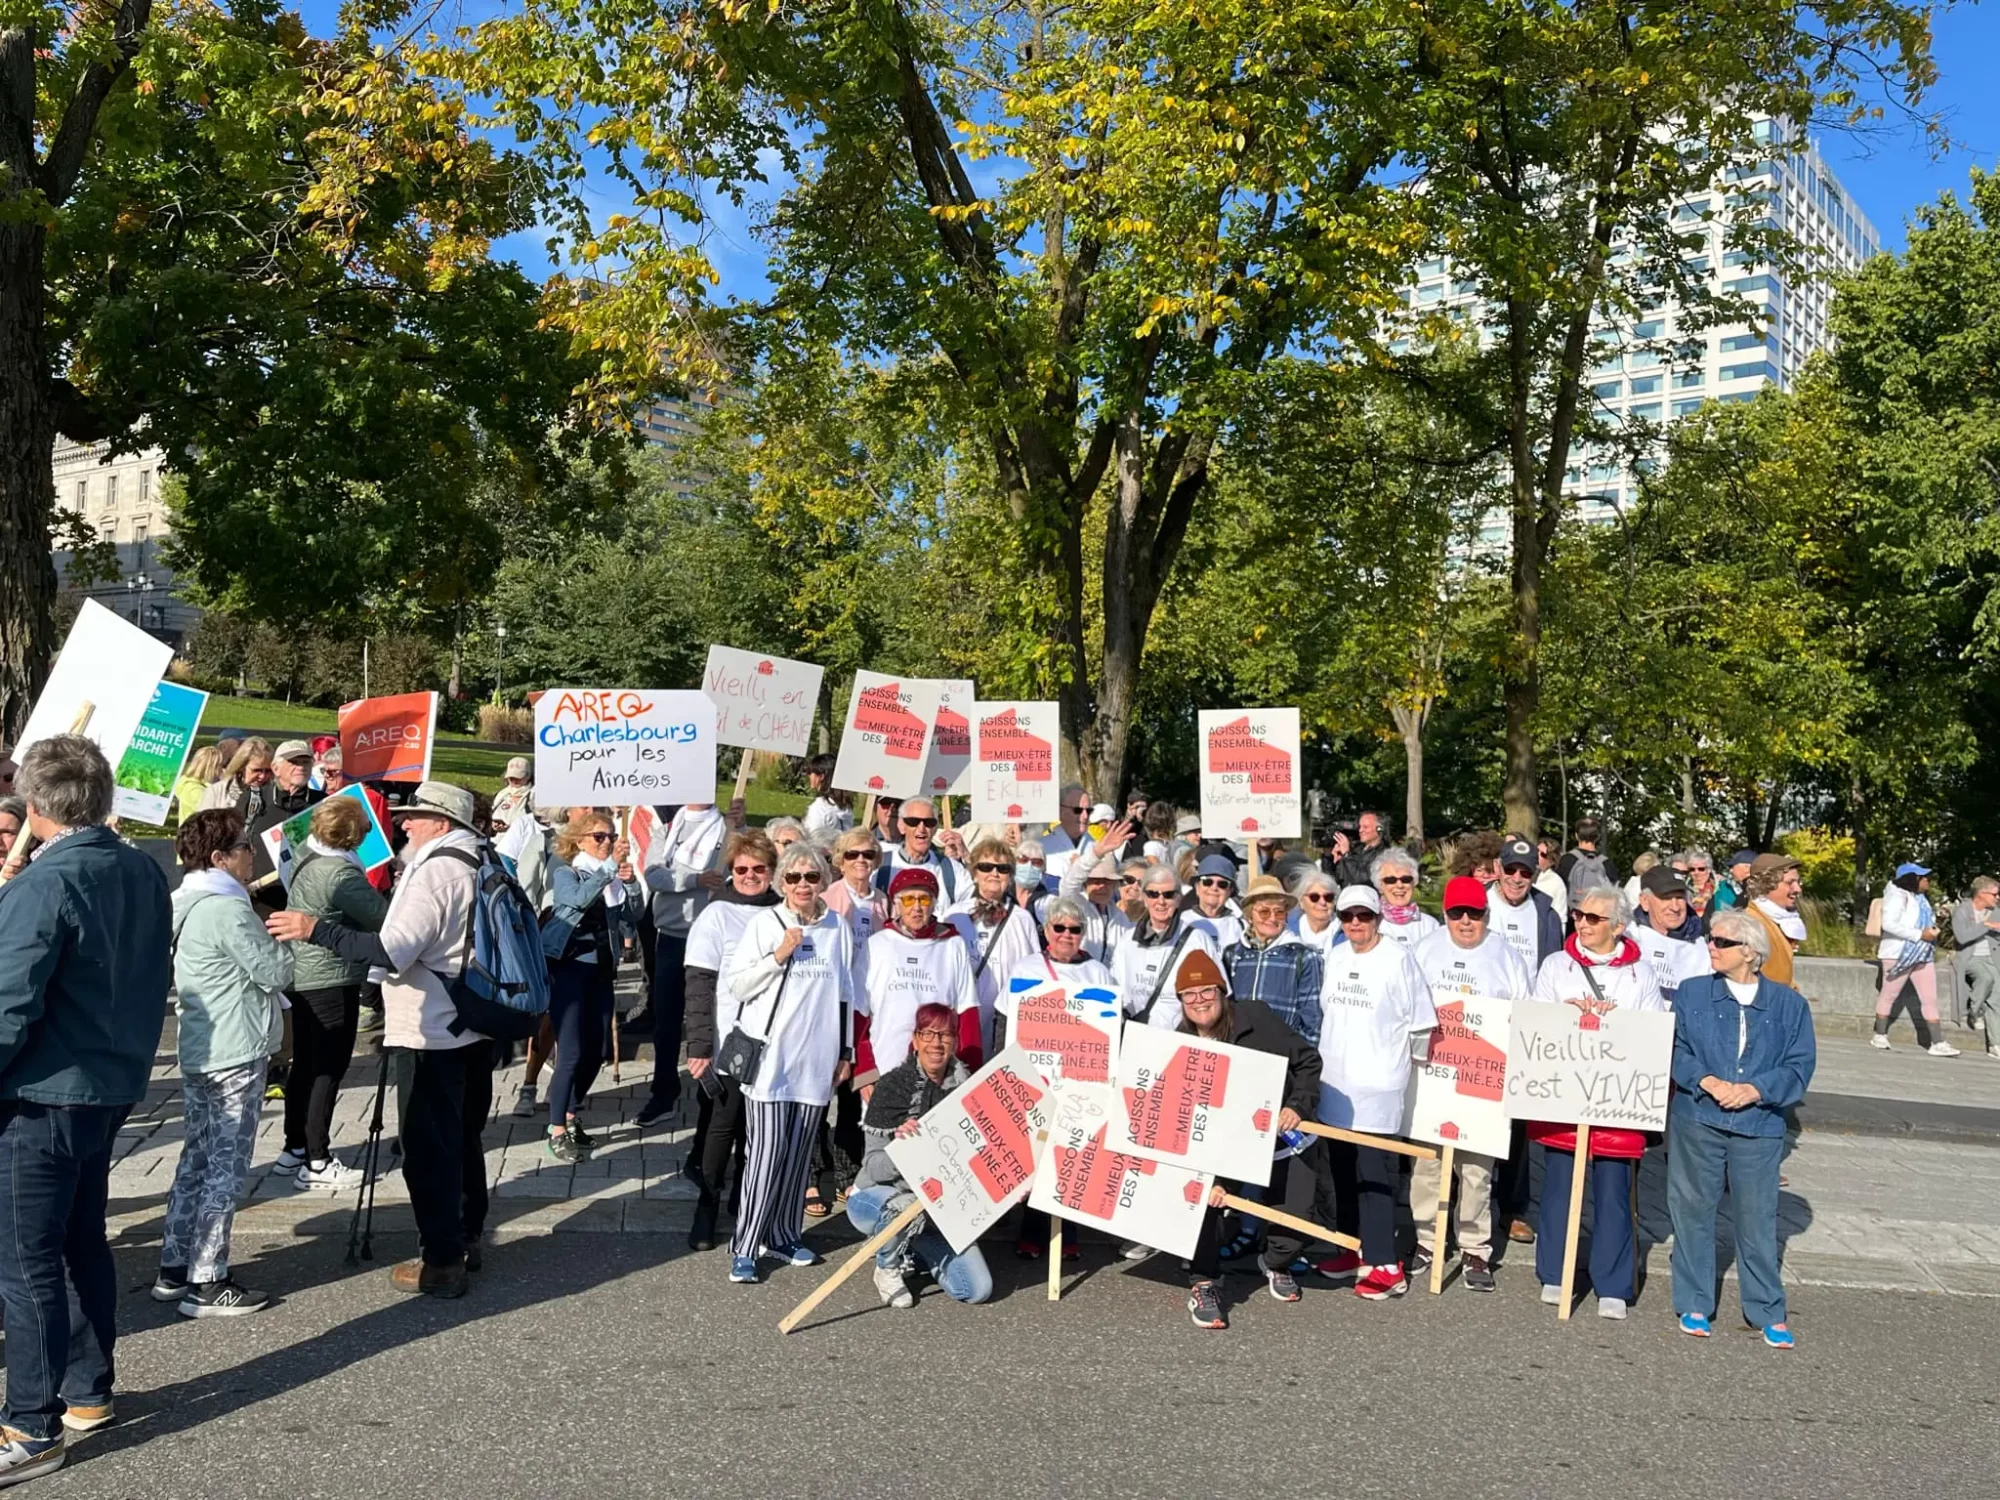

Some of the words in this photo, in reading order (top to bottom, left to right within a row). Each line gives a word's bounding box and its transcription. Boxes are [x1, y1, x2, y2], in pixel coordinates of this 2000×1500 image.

[861, 686, 913, 704] AGISSONS
[553, 691, 654, 723] AREQ
[858, 698, 909, 716] ENSEMBLE
[867, 721, 926, 740] MIEUX-ÊTRE
[980, 716, 1031, 727] AGISSONS
[1208, 724, 1267, 736] AGISSONS
[353, 723, 421, 750] AREQ
[539, 719, 697, 748] Charlesbourg
[862, 732, 882, 745] DES
[979, 728, 1029, 739] ENSEMBLE
[1208, 738, 1266, 749] ENSEMBLE
[569, 748, 617, 772] pour
[636, 743, 666, 763] les
[994, 748, 1052, 760] MIEUX-ÊTRE
[990, 763, 1010, 773] DES
[1225, 759, 1292, 771] MIEUX-ÊTRE
[1221, 774, 1243, 785] DES
[895, 967, 932, 981] Vieillir,
[1441, 969, 1478, 986] Vieillir,
[910, 980, 938, 993] vivre.
[1337, 981, 1369, 997] Vieillir,
[1019, 996, 1084, 1011] AGISSONS
[1347, 996, 1374, 1010] vivre.
[1017, 1010, 1082, 1026] ENSEMBLE
[1573, 1020, 1609, 1030] HABITATS
[1034, 1038, 1110, 1055] MIEUX-ÊTRE
[1029, 1053, 1054, 1066] DES
[1425, 1063, 1450, 1080] DES
[1000, 1064, 1046, 1128] AGISSONS
[1176, 1047, 1200, 1133] MIEUX-ÊTRE
[1574, 1069, 1667, 1111] VIVRE
[986, 1073, 1033, 1138] ENSEMBLE
[1127, 1067, 1150, 1145] AGISSONS
[1143, 1072, 1166, 1149] ENSEMBLE
[924, 1113, 939, 1139] Le
[1260, 1099, 1271, 1138] HABITATS
[958, 1117, 980, 1145] DES
[1192, 1114, 1207, 1142] DES
[975, 1110, 1028, 1184] MIEUX-ÊTRE
[1053, 1127, 1084, 1204] AGISSONS
[1069, 1134, 1100, 1210] ENSEMBLE
[938, 1164, 957, 1186] est
[1105, 1153, 1125, 1198] MIEUX
[919, 1175, 945, 1210] HABITATS
[1119, 1178, 1138, 1209] DES
